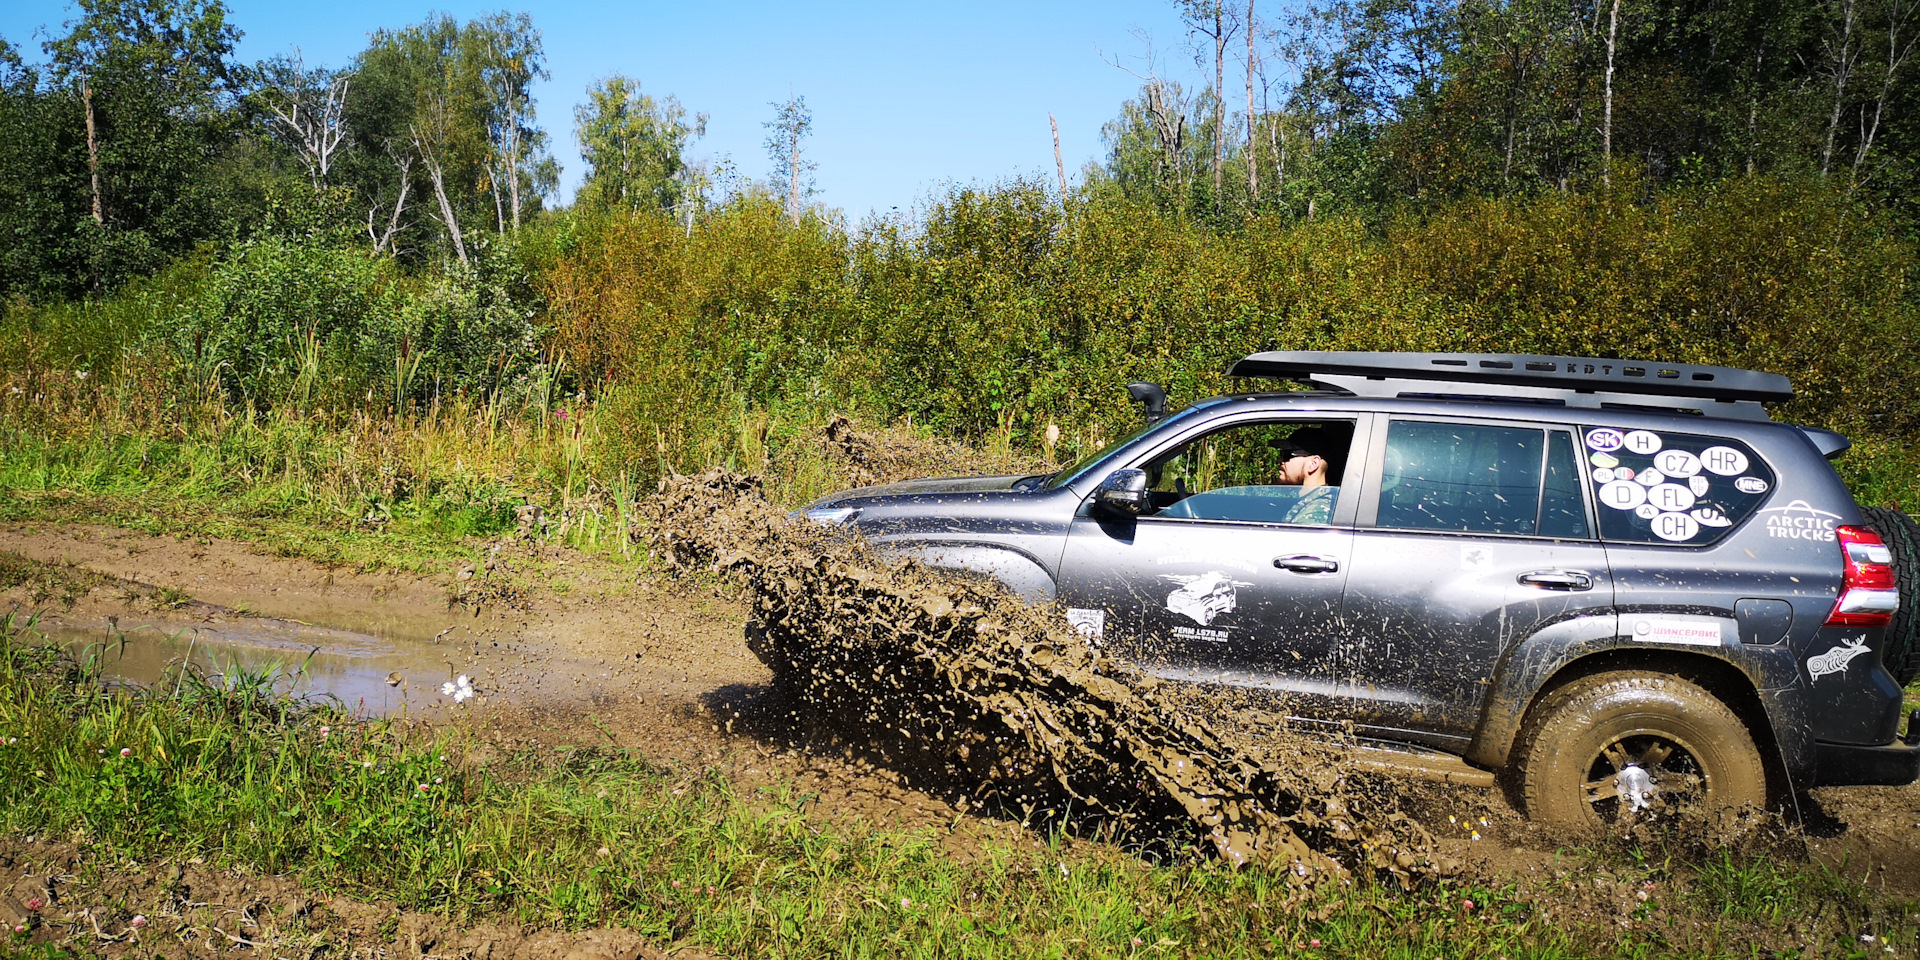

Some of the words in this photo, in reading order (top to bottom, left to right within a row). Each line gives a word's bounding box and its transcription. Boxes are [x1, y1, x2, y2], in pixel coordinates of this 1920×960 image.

[1592, 432, 1619, 447] SK
[1636, 435, 1649, 449] H
[1665, 454, 1690, 474] CZ
[1710, 450, 1737, 471] HR
[1597, 471, 1608, 480] PL
[1645, 470, 1653, 482] F
[1738, 478, 1765, 490] MNE
[1616, 486, 1631, 504] D
[1663, 488, 1684, 507] FL
[1642, 507, 1652, 516] A
[1662, 516, 1686, 537] CH
[1766, 515, 1833, 530] ARCTIC
[1766, 525, 1836, 542] TRUCKS
[1653, 627, 1719, 638] ШИНСЕРВИС
